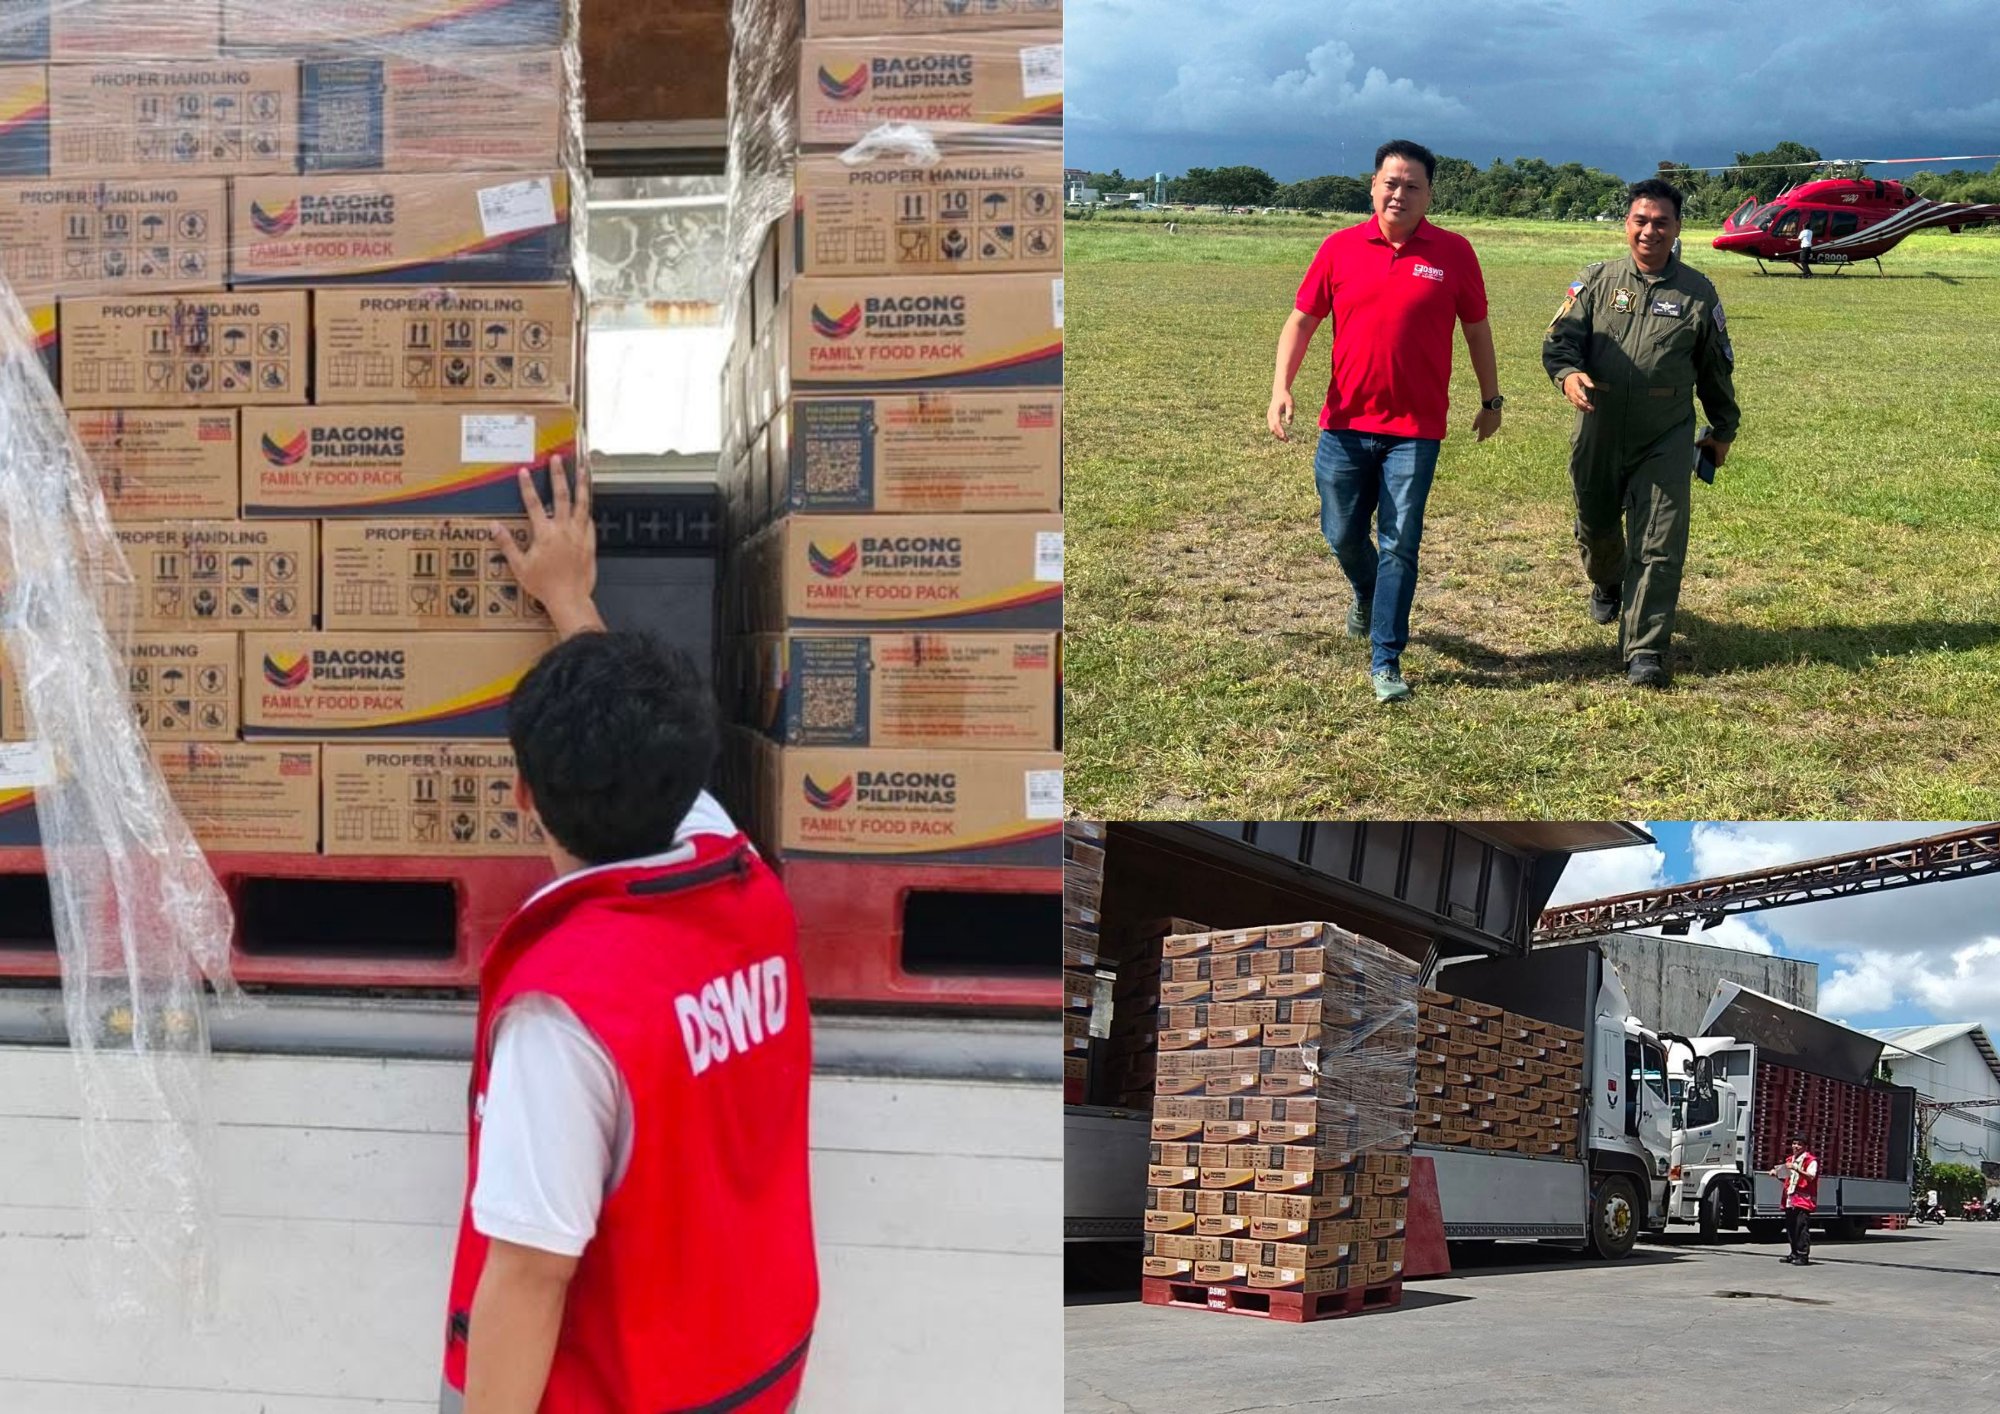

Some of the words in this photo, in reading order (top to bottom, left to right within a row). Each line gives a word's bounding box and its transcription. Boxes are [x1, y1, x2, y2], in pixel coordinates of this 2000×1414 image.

[872, 55, 973, 73] BAGONG
[92, 72, 160, 86] PROPER
[164, 71, 250, 85] HANDLING
[872, 72, 973, 89] PILIPINAS
[877, 106, 922, 119] FOOD
[927, 103, 971, 119] PACK
[849, 170, 924, 185] PROPER
[929, 166, 1025, 184] HANDLING
[20, 190, 88, 203] PROPER
[93, 190, 178, 203] HANDLING
[300, 195, 394, 209] BAGONG
[300, 211, 394, 224] PILIPINAS
[304, 242, 348, 256] FOOD
[352, 241, 393, 256] PACK
[1422, 265, 1444, 276] DSWD
[102, 304, 168, 318] PROPER
[360, 299, 430, 312] PROPER
[435, 298, 524, 312] HANDLING
[865, 296, 965, 312] BAGONG
[865, 313, 965, 328] PILIPINAS
[809, 347, 864, 361] FAMILY
[869, 345, 915, 360] FOOD
[920, 344, 964, 359] PACK
[311, 426, 404, 441] BAGONG
[311, 443, 405, 457] PILIPINAS
[260, 472, 312, 486] FAMILY
[315, 471, 358, 485] FOOD
[362, 471, 403, 485] PACK
[183, 531, 268, 544] HANDLING
[365, 528, 434, 541] PROPER
[862, 538, 961, 552] BAGONG
[862, 555, 961, 568] PILIPINAS
[806, 584, 861, 598] FAMILY
[866, 585, 911, 599] FOOD
[916, 586, 960, 599] PACK
[312, 650, 405, 665] BAGONG
[312, 667, 405, 680] PILIPINAS
[262, 695, 313, 709] FAMILY
[318, 696, 358, 709] FOOD
[363, 696, 403, 710] PACK
[366, 754, 435, 767] PROPER
[440, 754, 514, 768] HANDLIN
[857, 771, 956, 788] BAGONG
[857, 789, 956, 804] PILIPINAS
[801, 817, 856, 832] FAMILY
[861, 818, 905, 834] FOOD
[910, 820, 954, 835] PACK
[674, 955, 787, 1077] DSWD
